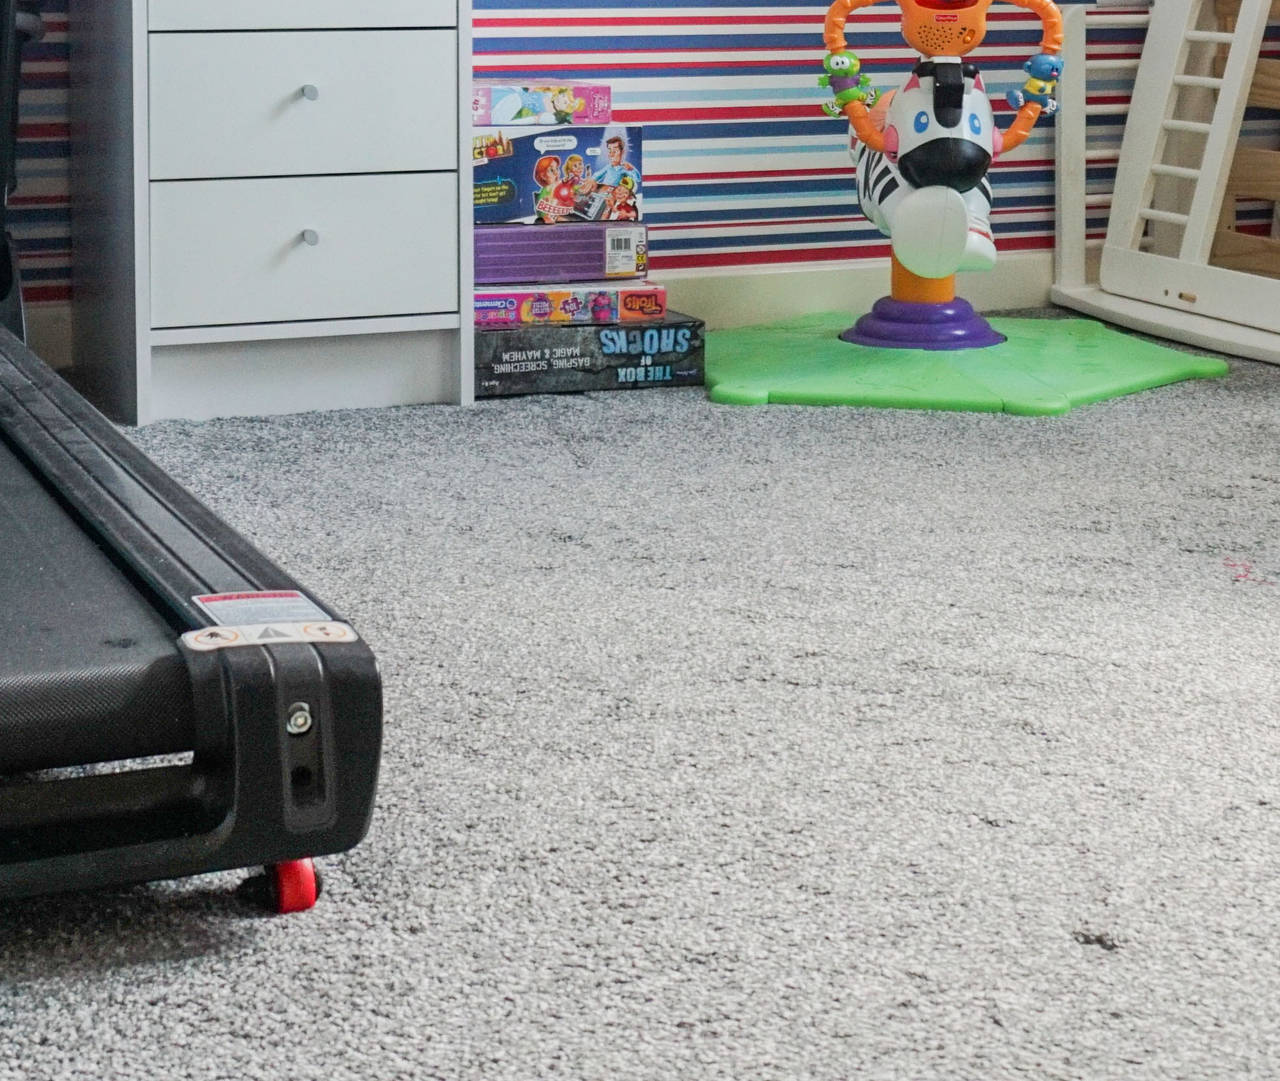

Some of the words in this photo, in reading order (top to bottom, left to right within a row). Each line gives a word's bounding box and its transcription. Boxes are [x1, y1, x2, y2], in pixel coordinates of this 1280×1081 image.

[600, 328, 691, 355] SHOCKS
[501, 349, 541, 362] MAYHEM
[552, 346, 580, 357] MAGIC
[640, 355, 652, 366] OF
[492, 361, 548, 374] SCREECHING,
[647, 365, 673, 381] THE
[617, 367, 645, 382] BOX
